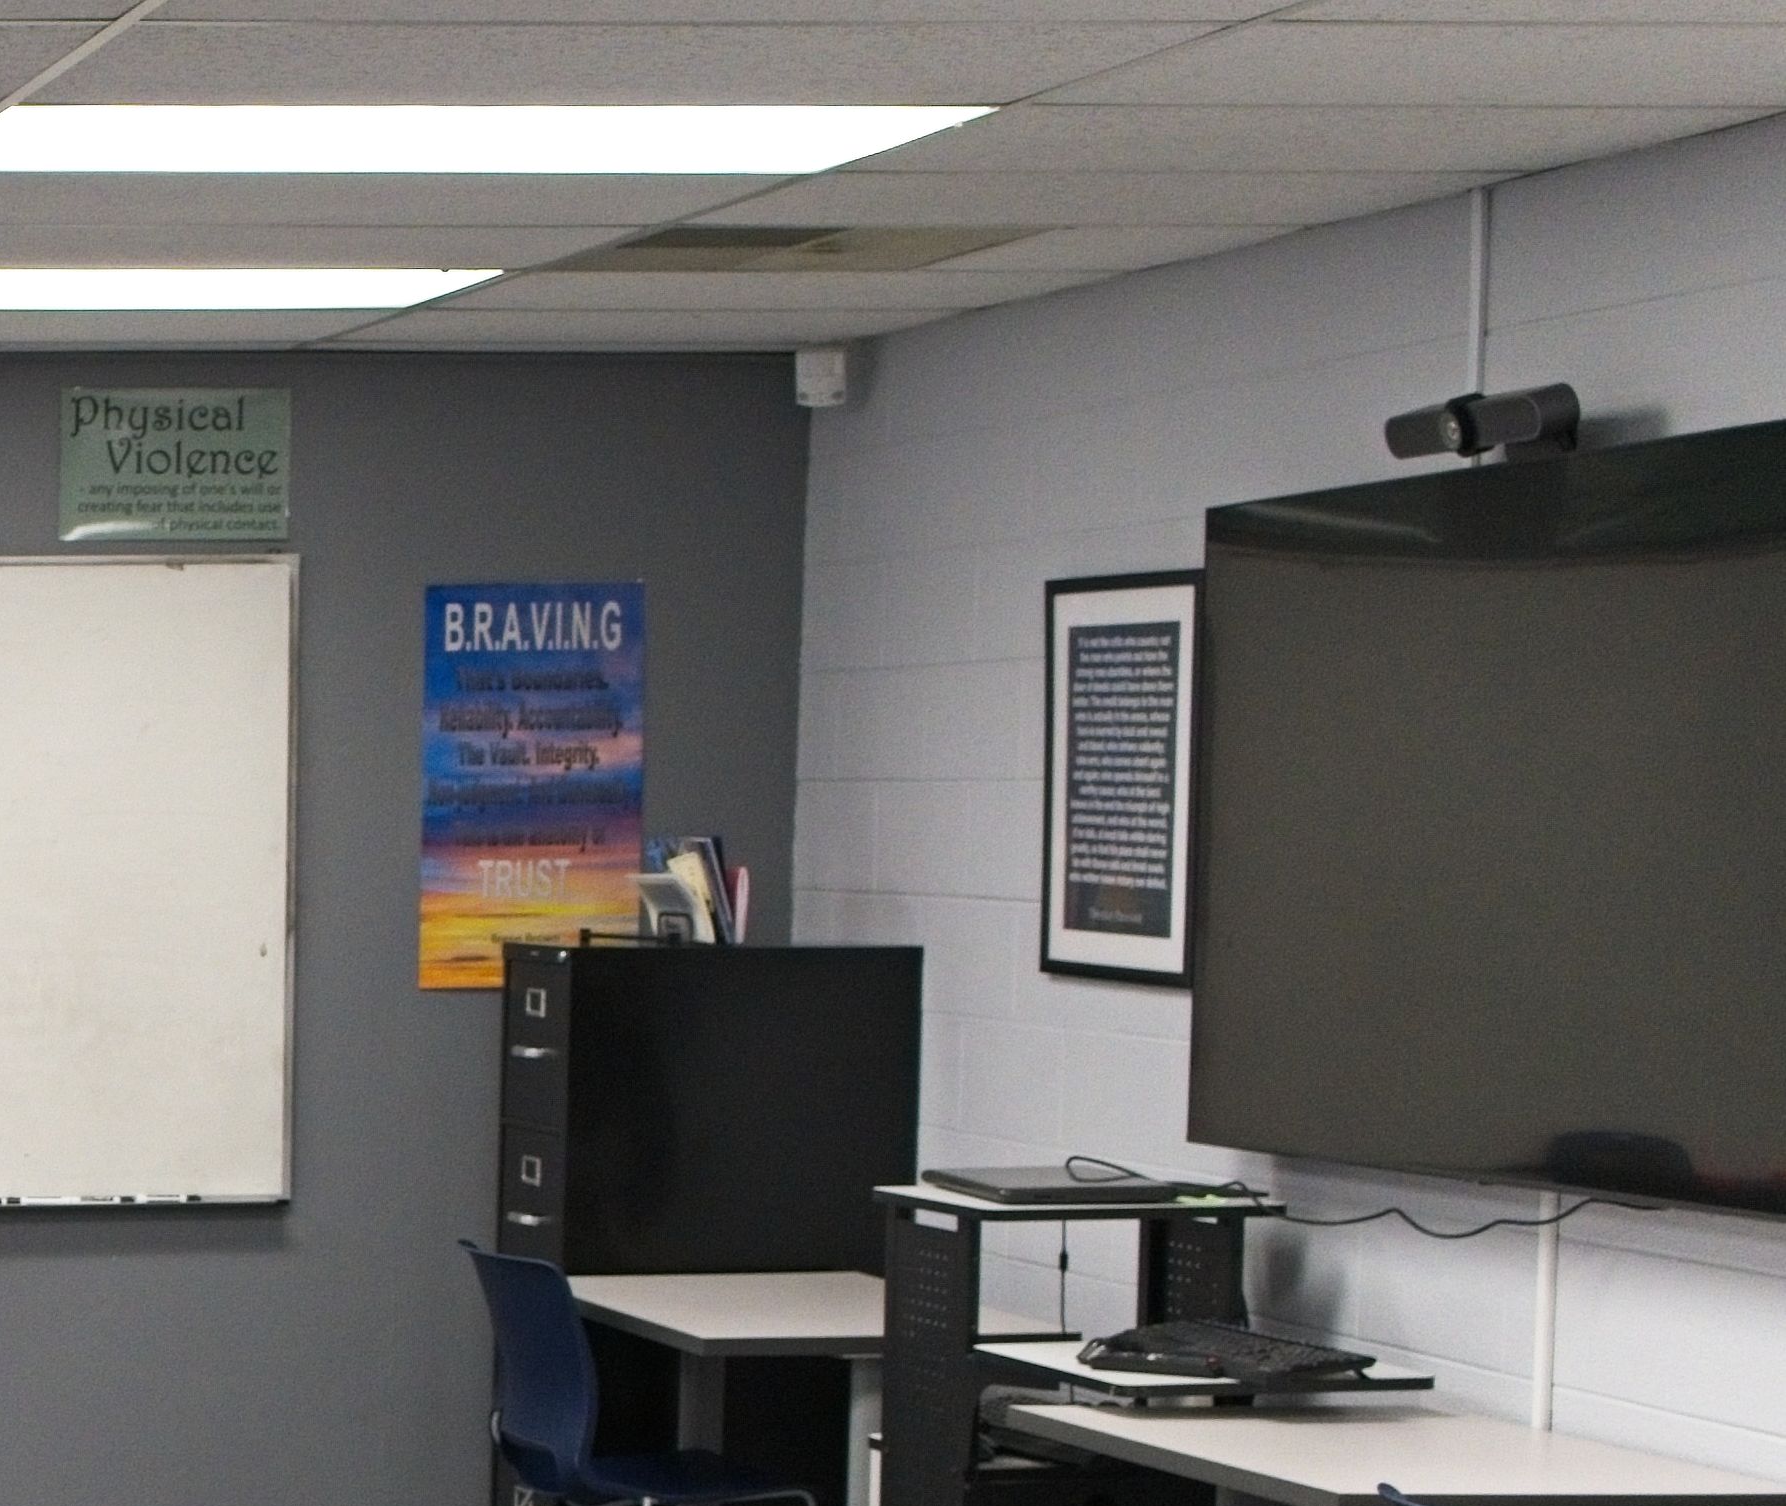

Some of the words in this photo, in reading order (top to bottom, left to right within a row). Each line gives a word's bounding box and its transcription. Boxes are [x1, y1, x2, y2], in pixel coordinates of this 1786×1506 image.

[69, 394, 247, 441] Physical
[106, 437, 279, 479] Violence
[77, 500, 134, 516] creating
[136, 499, 164, 513] fear
[166, 499, 195, 513] that
[197, 499, 255, 514] includes
[88, 484, 113, 497] any
[116, 482, 177, 498] imposing
[182, 482, 197, 496] of
[444, 601, 622, 652] B.R.A.V.I.N.G
[477, 857, 572, 898] TRUST
